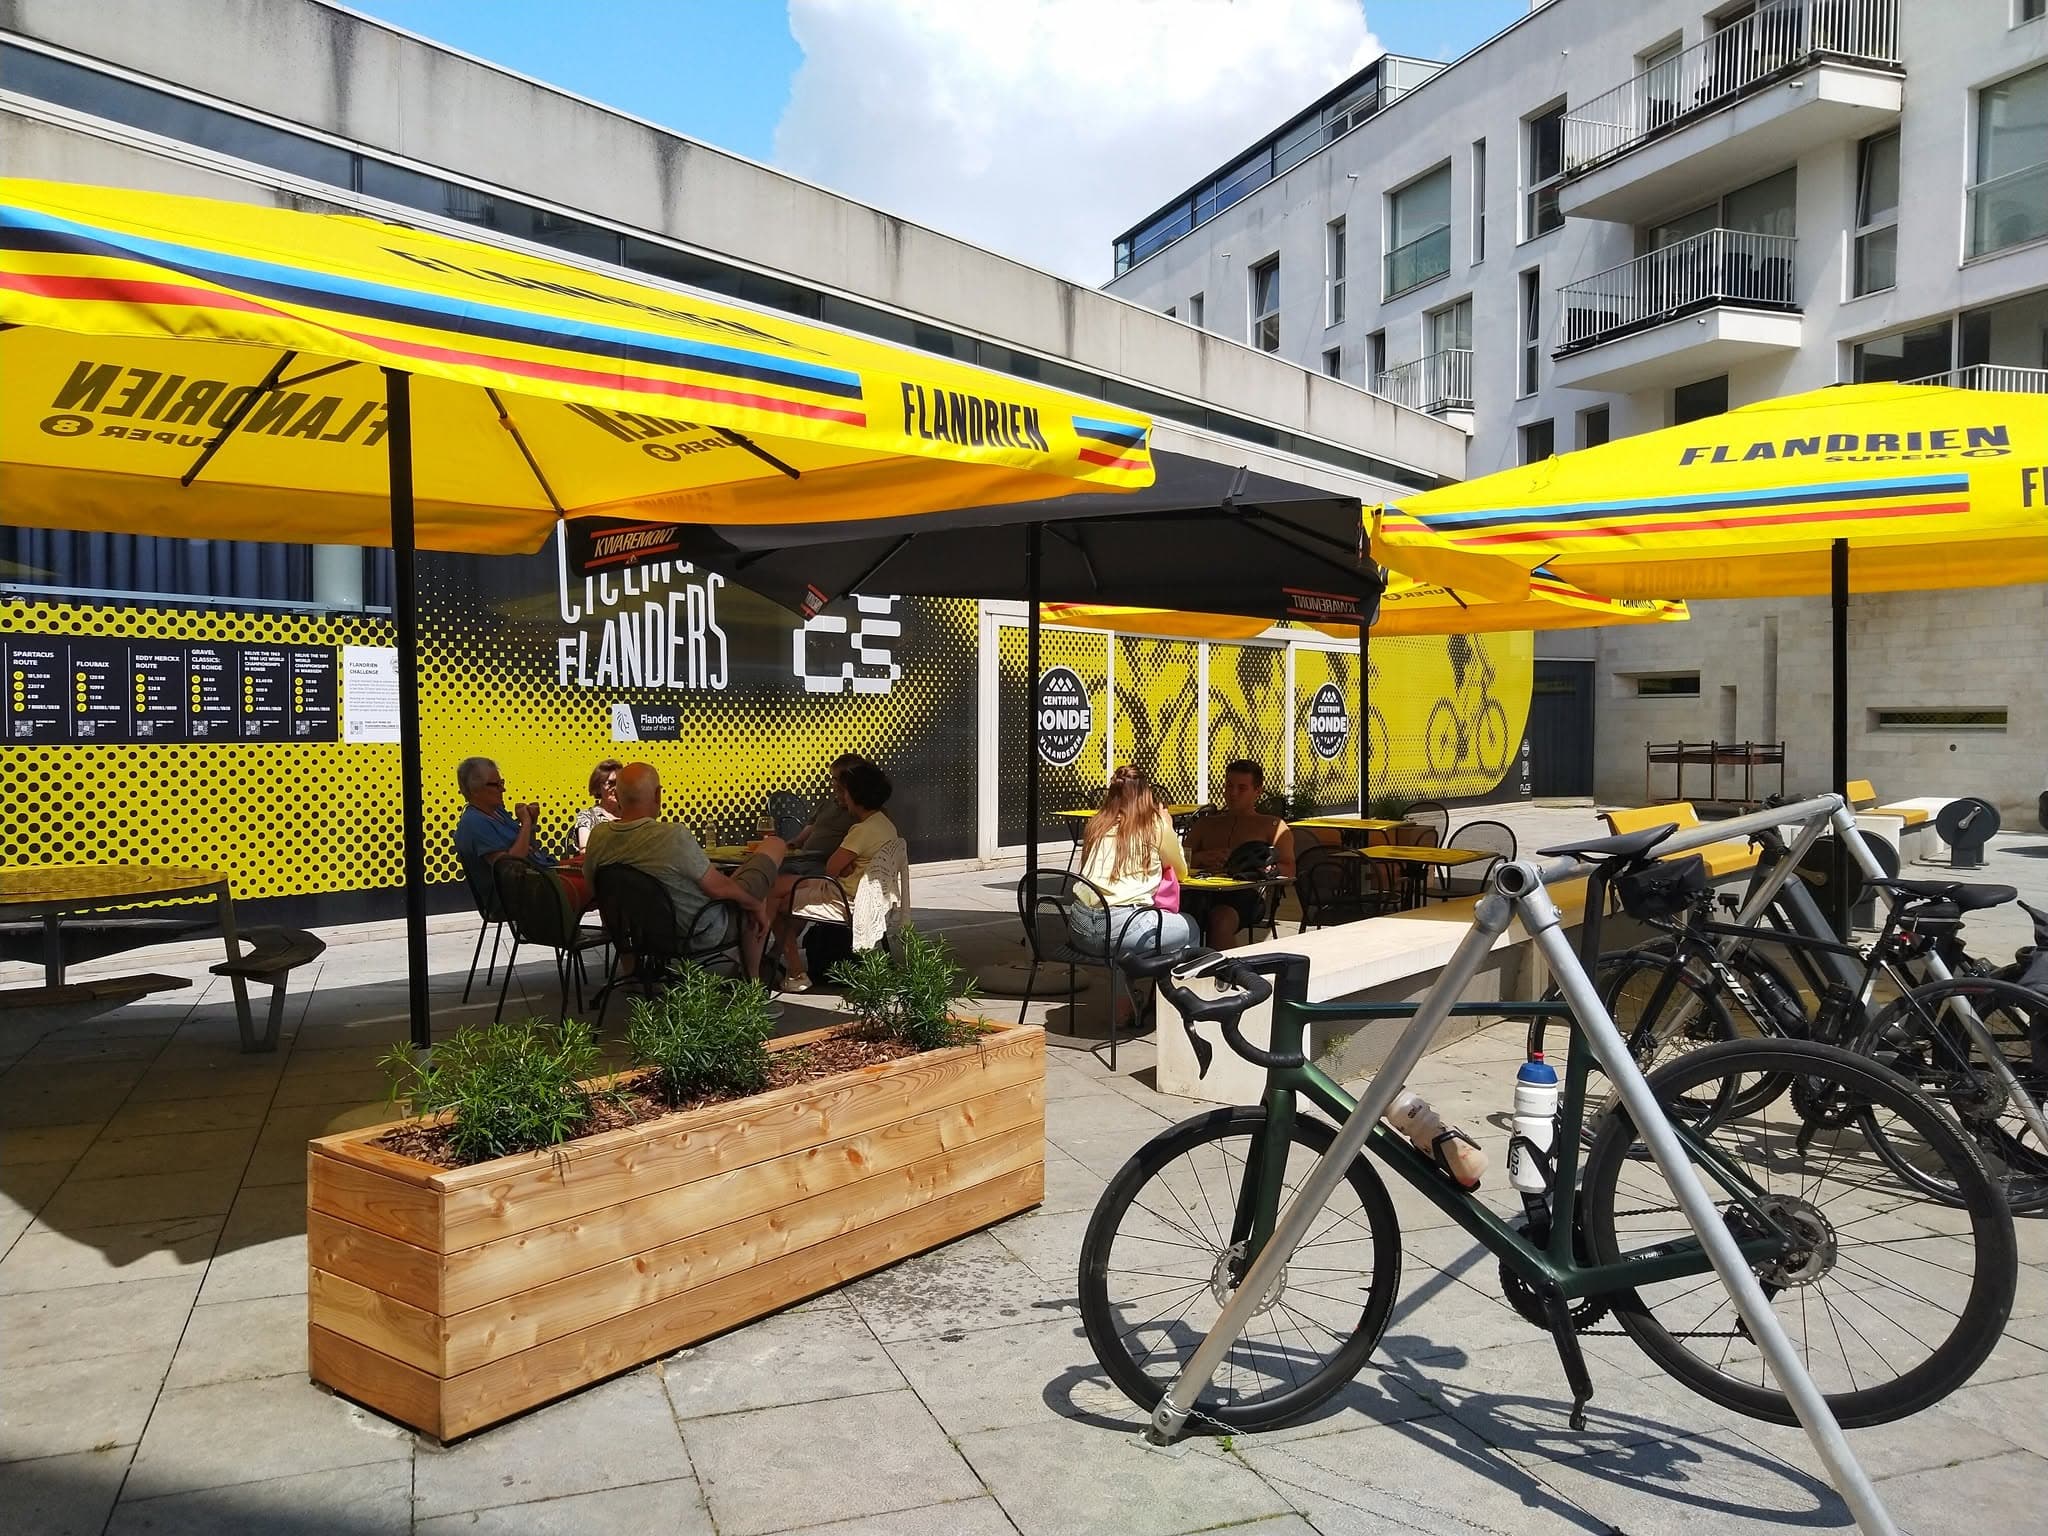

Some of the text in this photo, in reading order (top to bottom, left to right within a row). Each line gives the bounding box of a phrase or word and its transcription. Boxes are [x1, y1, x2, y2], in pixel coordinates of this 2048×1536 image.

[901, 382, 1049, 453] FLANDRIEN
[1679, 425, 2009, 466] FLANDRIEN
[1824, 452, 1950, 462] SUPER
[594, 527, 679, 558] KWAREMONT
[558, 572, 728, 690] FLANDERS
[13, 651, 54, 659] SPARTACUS
[1042, 696, 1079, 706] CENTRUM
[641, 714, 675, 724] Flanders
[1311, 716, 1347, 733] RONDE
[1040, 735, 1082, 759] VLAANDEREN
[1053, 735, 1069, 745] VAN
